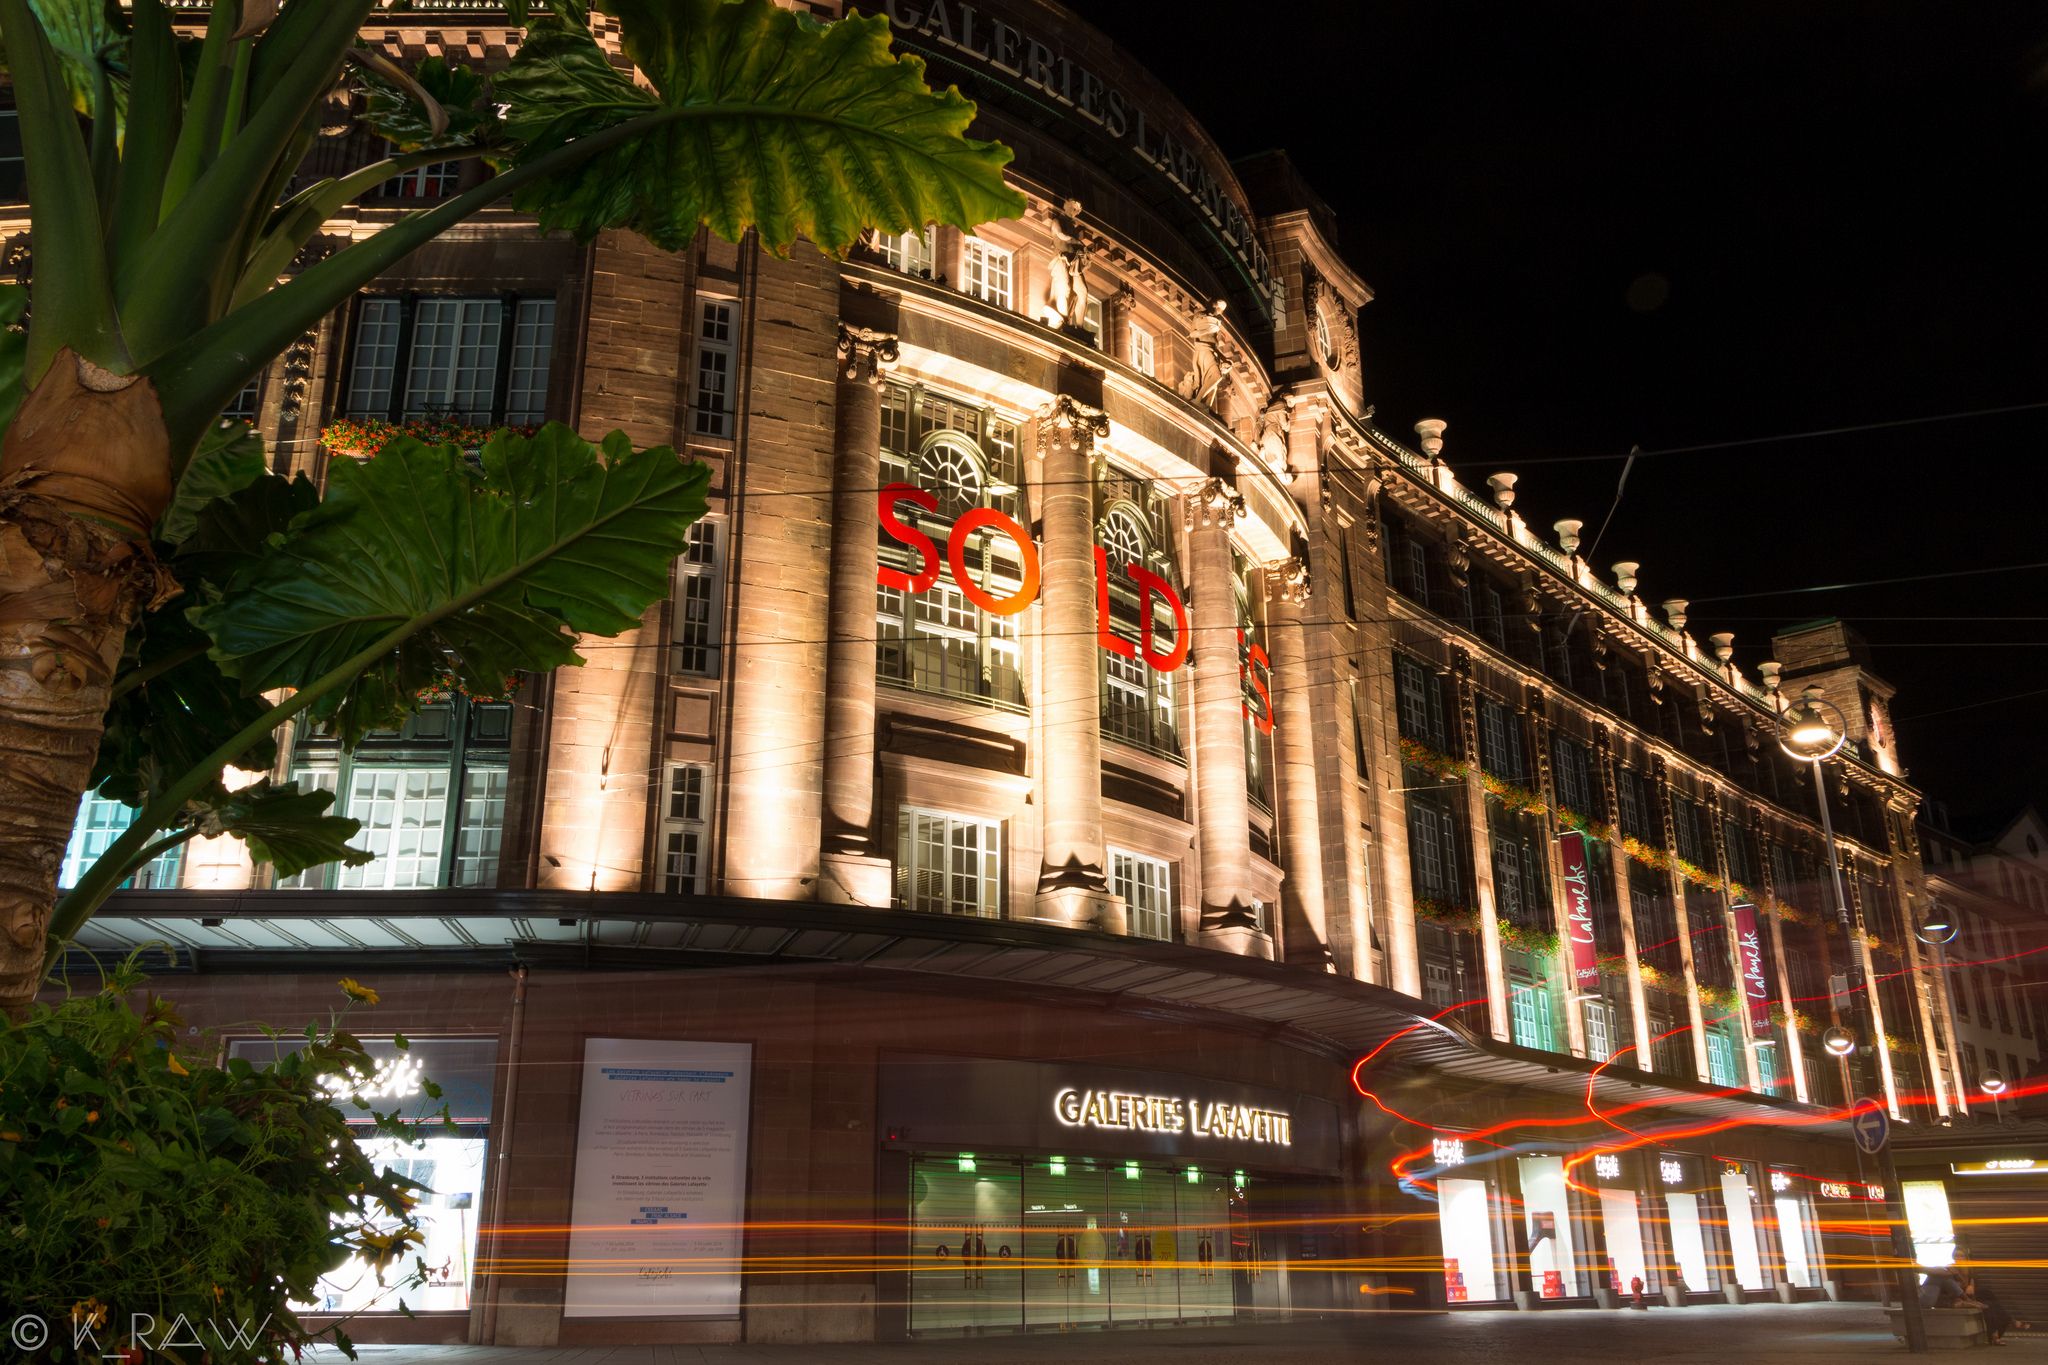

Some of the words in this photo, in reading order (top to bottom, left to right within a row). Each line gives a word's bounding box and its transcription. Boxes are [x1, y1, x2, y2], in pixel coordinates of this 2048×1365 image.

[885, 0, 1128, 137] GALERIES
[1055, 1088, 1187, 1132] GALERIES
[1190, 1100, 1290, 1144] LAFAYETTE
